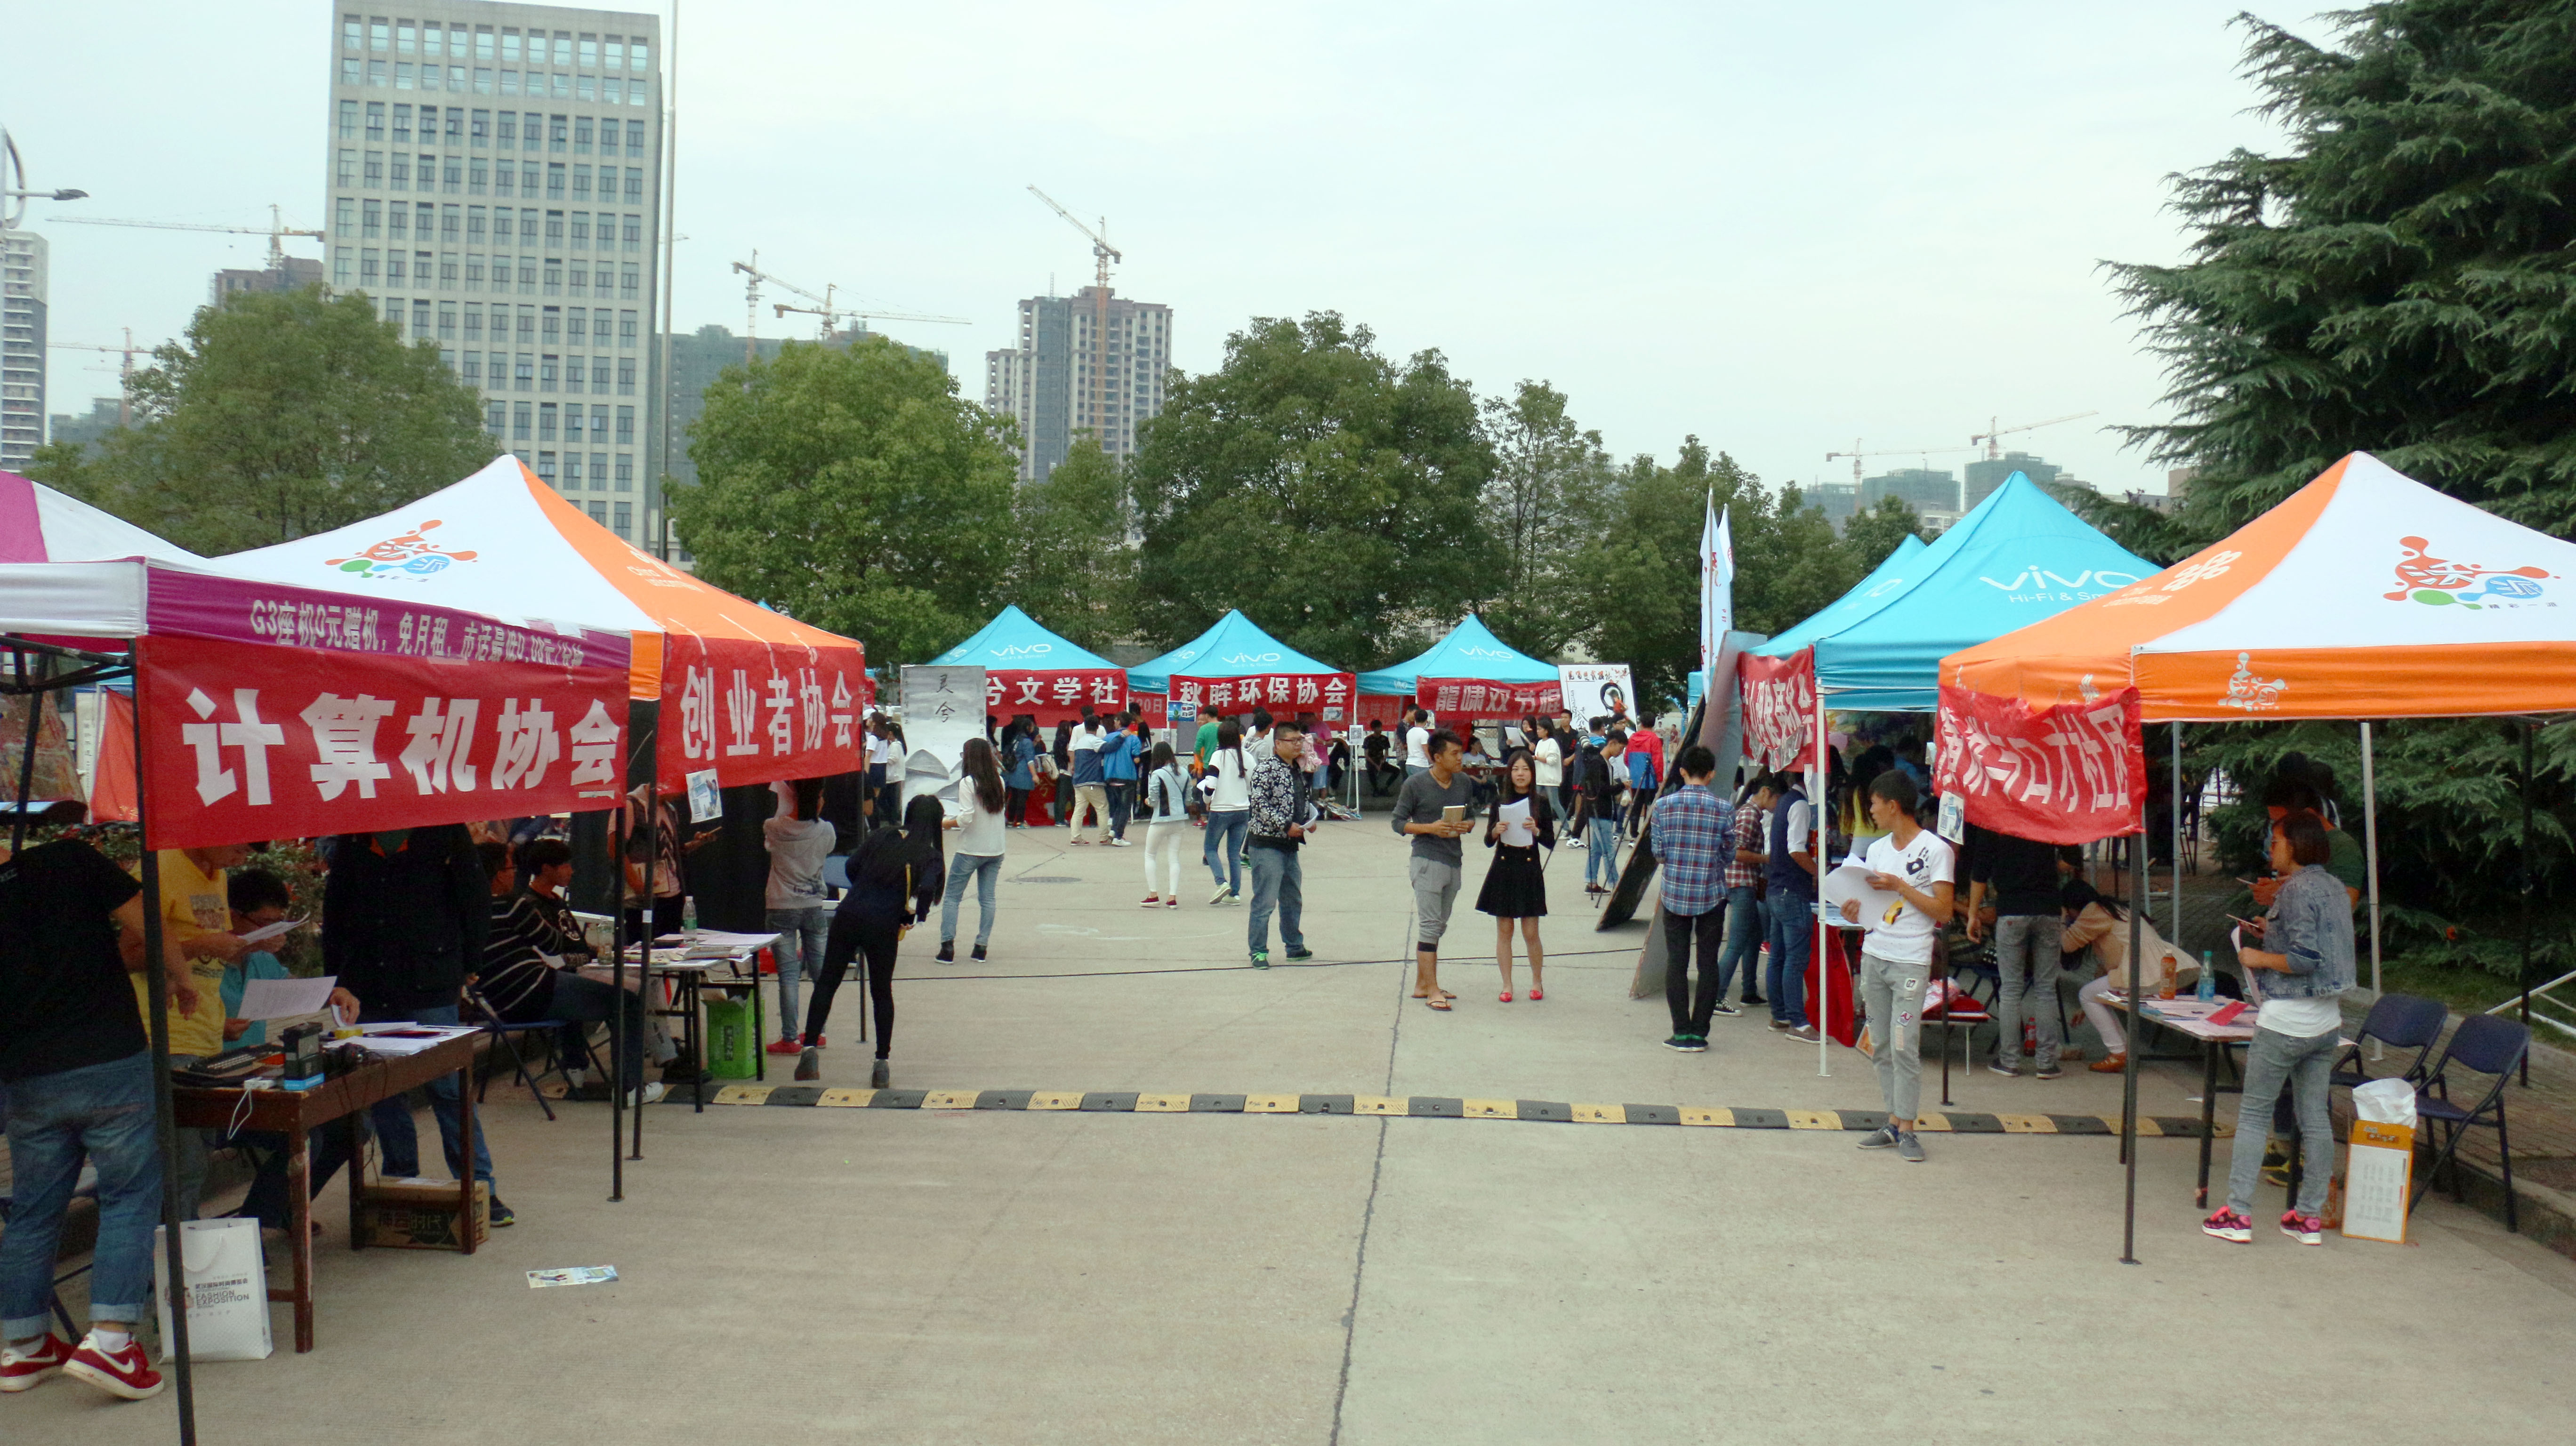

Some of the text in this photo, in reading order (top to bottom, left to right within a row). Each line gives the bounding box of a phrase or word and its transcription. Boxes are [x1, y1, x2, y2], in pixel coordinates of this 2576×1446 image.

[2008, 593, 2054, 603] Hi-Fi
[2059, 592, 2073, 602] &
[990, 643, 1052, 656] vivo
[1458, 645, 1513, 659] vivo
[1222, 652, 1281, 664] vivo
[1179, 676, 1347, 708] 秋眸环保协会
[680, 665, 853, 761] 创业者协会
[182, 687, 620, 807] 计算机协会
[196, 1290, 234, 1300] FASHION
[196, 1293, 250, 1306] EXPOSITION
